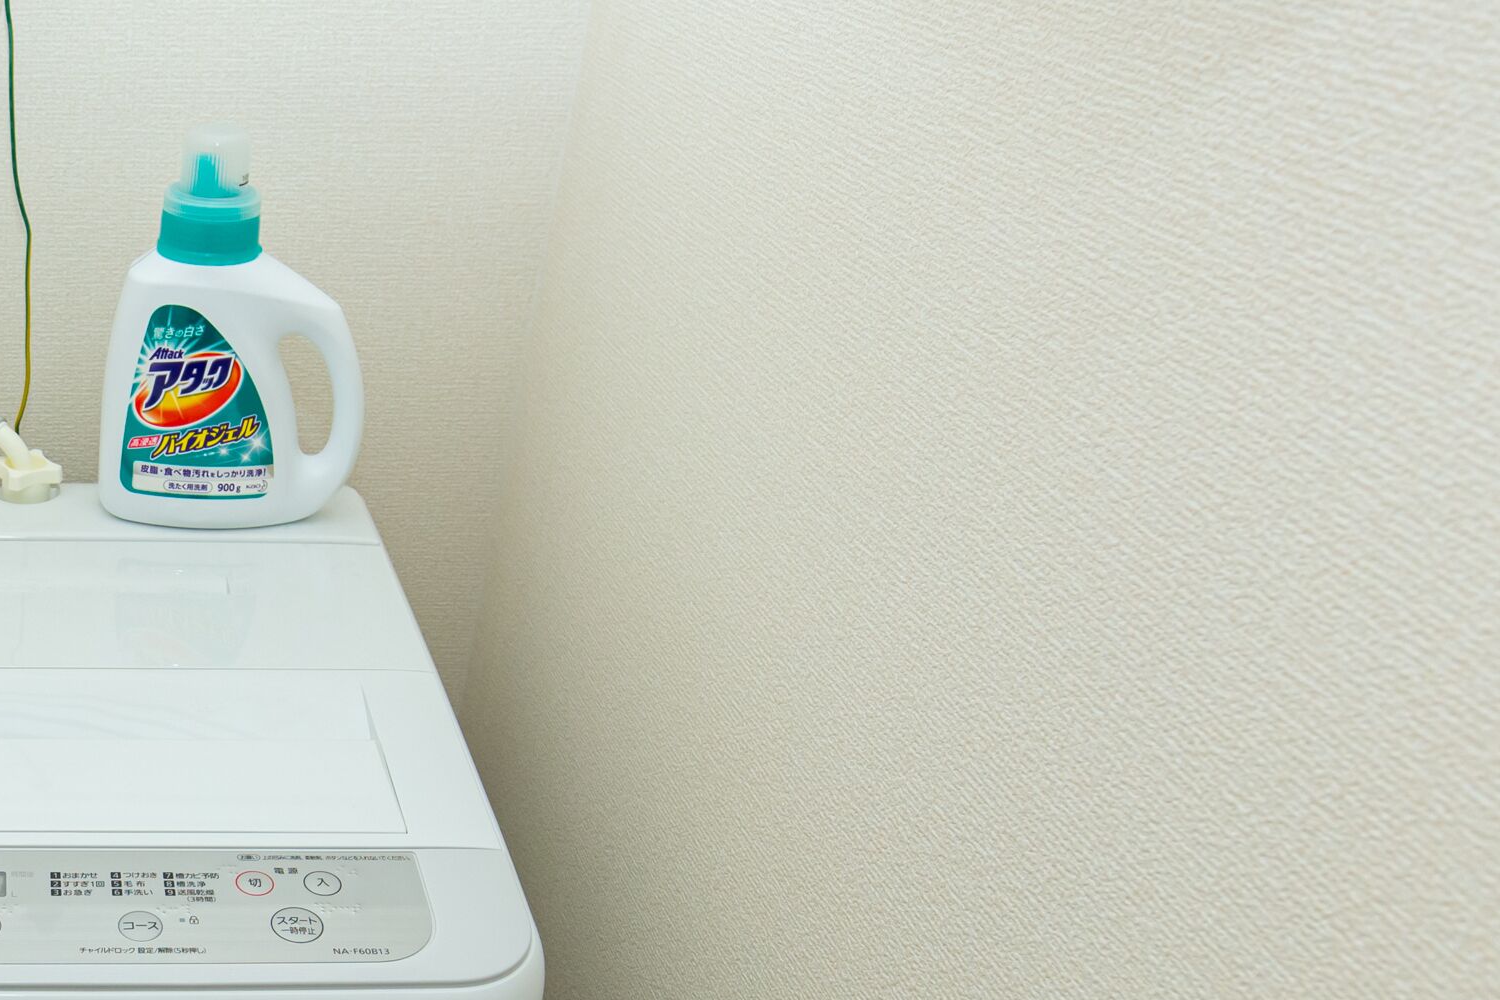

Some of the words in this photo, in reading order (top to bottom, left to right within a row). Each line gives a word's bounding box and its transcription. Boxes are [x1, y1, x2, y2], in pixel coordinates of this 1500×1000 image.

[153, 325, 205, 340] 驚きの白さ
[149, 347, 184, 360] Attack
[143, 357, 233, 409] アタック
[150, 415, 260, 459] バイオジェル
[175, 872, 220, 880] 槽カビ予防
[274, 867, 299, 875] 電源
[63, 880, 106, 888] すすぎ1回
[124, 880, 146, 888] 毛布
[176, 880, 206, 888] 槽洗浄
[248, 878, 262, 888] 切
[316, 877, 330, 887] 入
[63, 888, 93, 896] お急ぎ
[124, 888, 154, 896] 手洗い
[276, 915, 318, 926] スタート
[122, 921, 160, 931] コース
[281, 926, 316, 936] 一時停止
[79, 947, 135, 955] チャイルドロック
